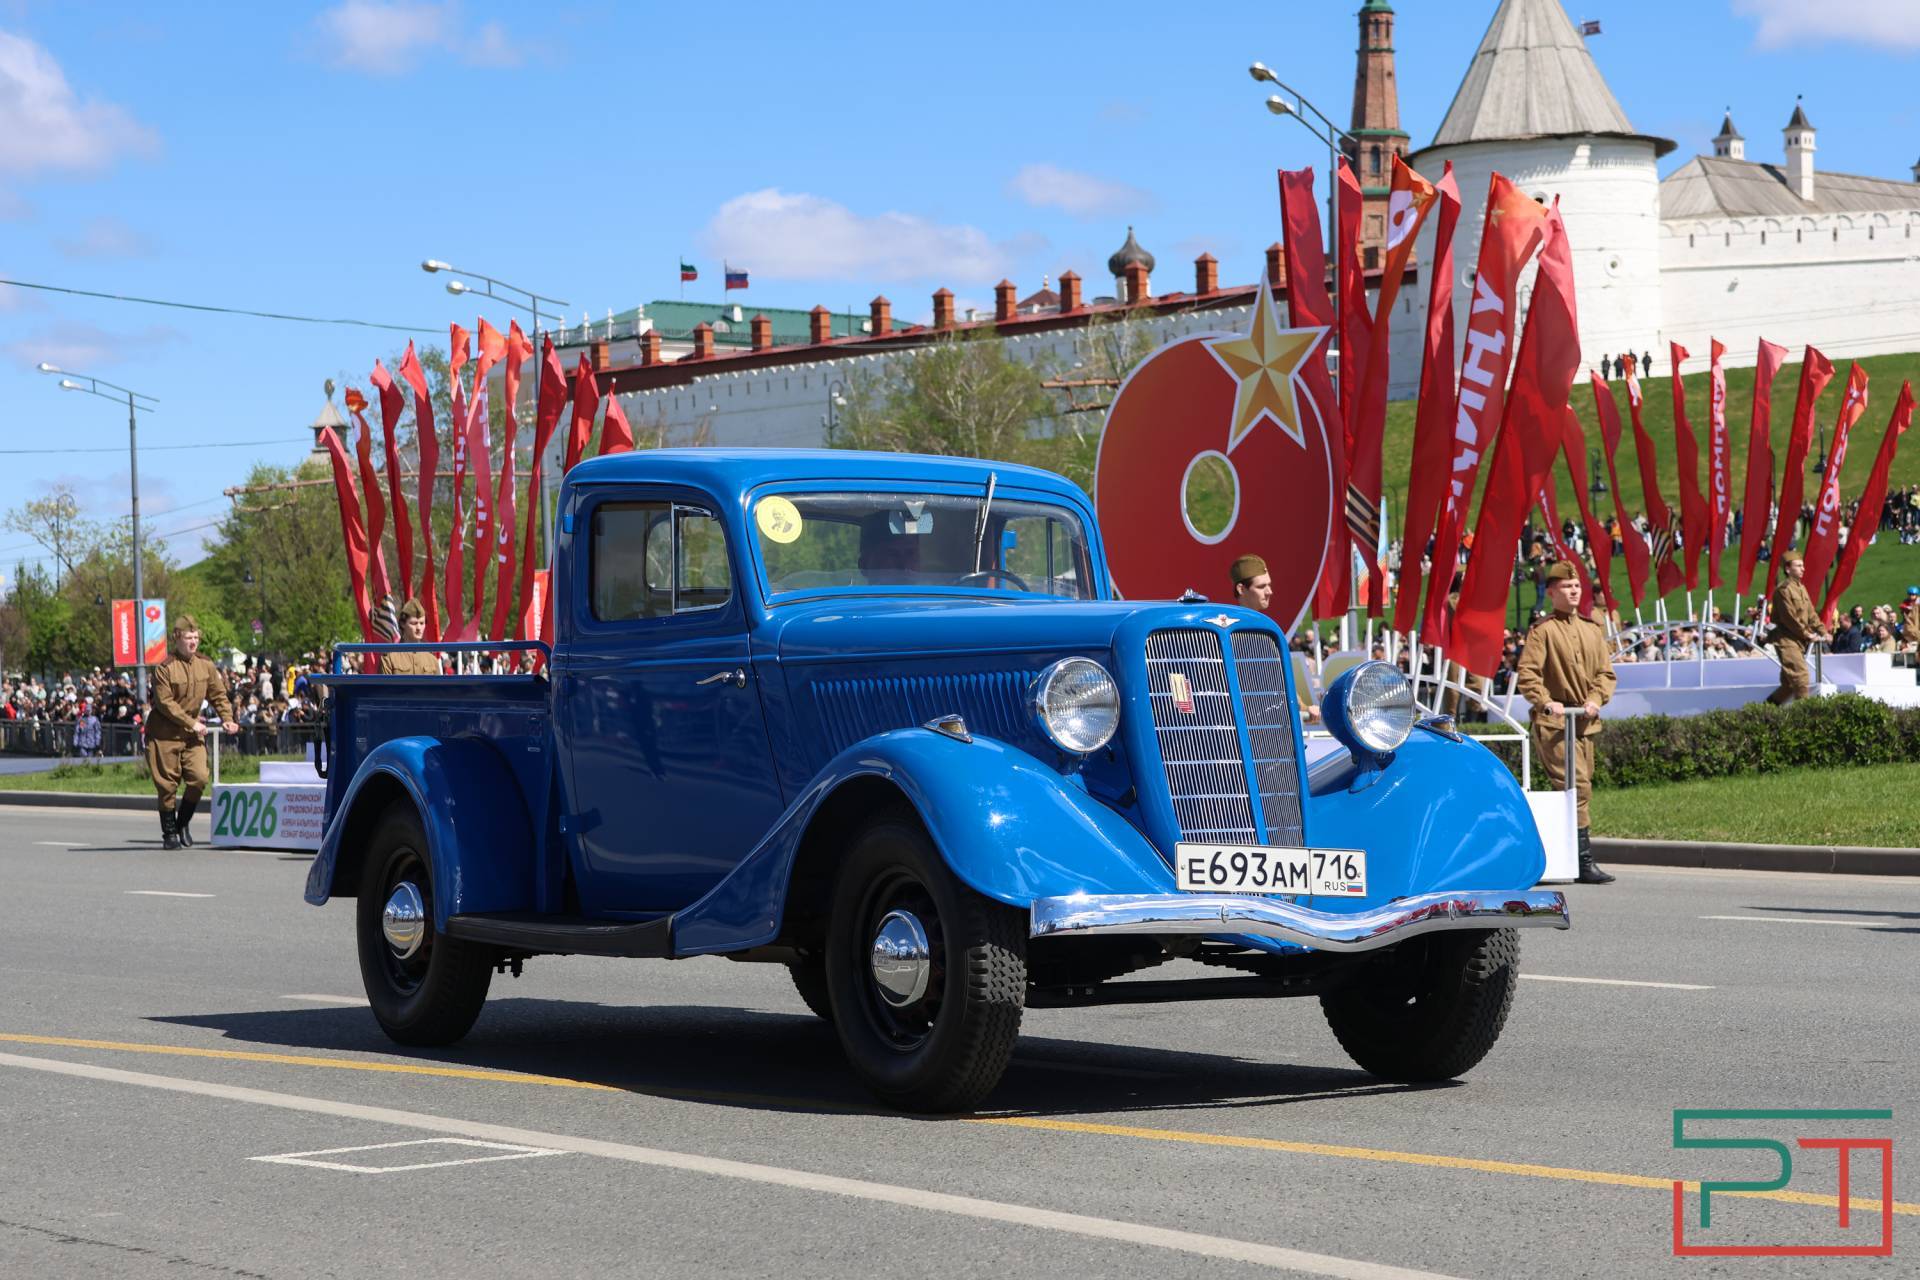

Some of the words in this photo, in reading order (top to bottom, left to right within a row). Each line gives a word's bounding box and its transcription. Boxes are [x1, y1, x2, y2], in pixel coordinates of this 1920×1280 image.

[214, 790, 278, 839] 2026
[1188, 851, 1308, 889] Е693АМ
[1313, 854, 1357, 880] 716
[1325, 881, 1346, 892] RUS
